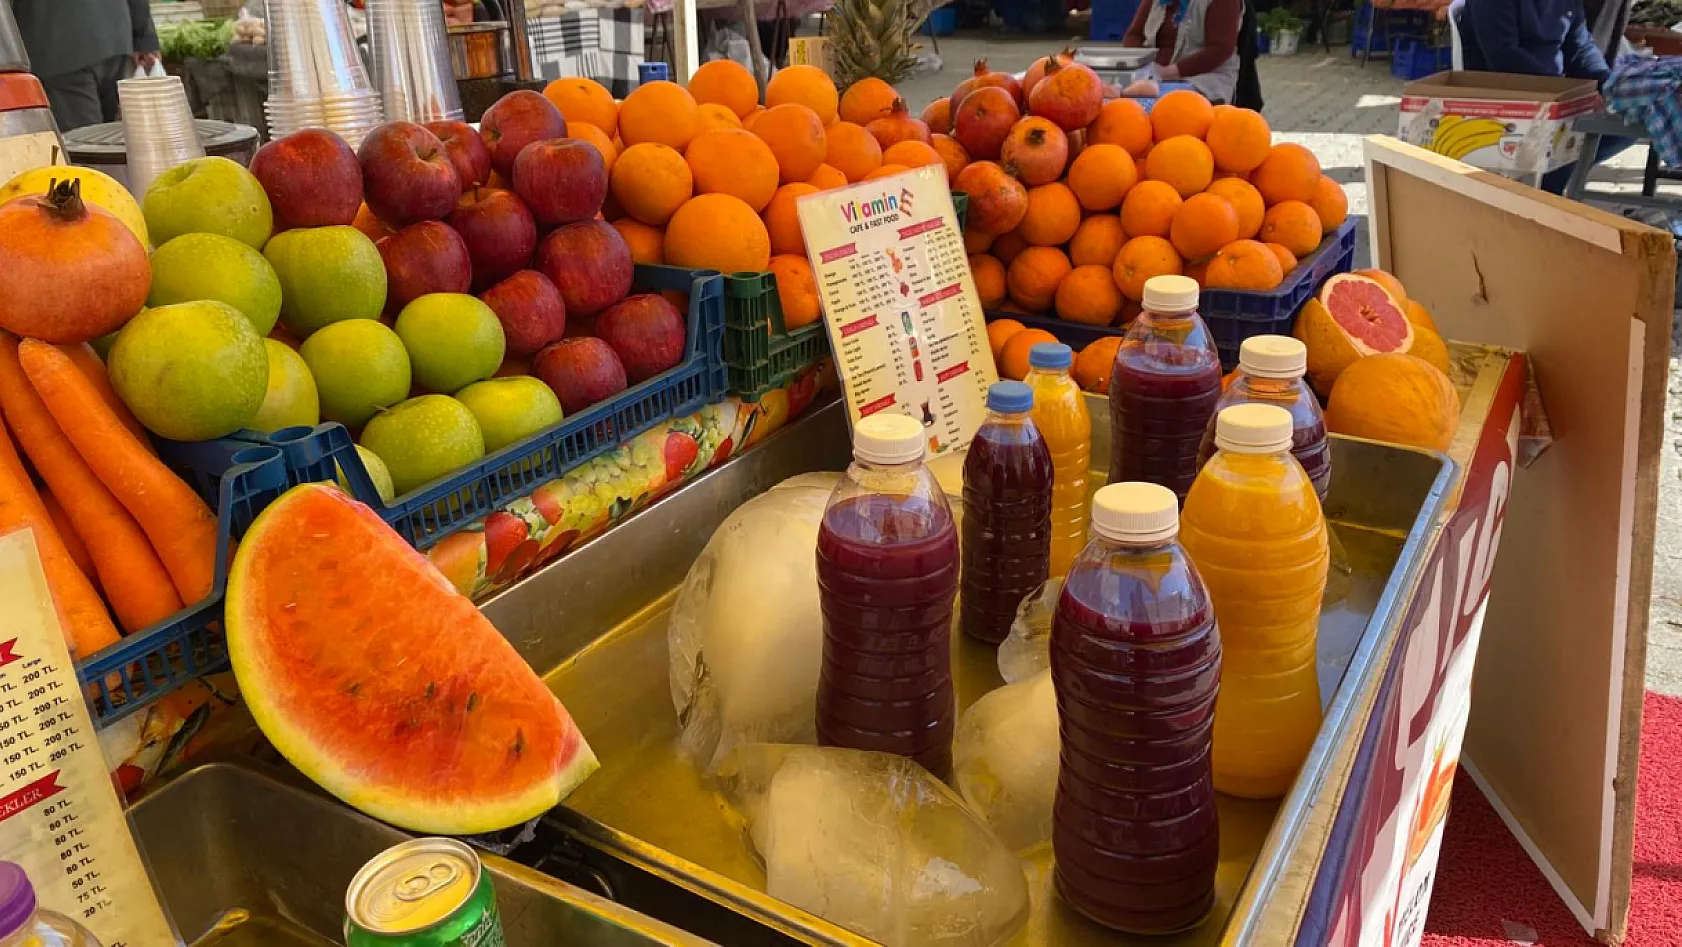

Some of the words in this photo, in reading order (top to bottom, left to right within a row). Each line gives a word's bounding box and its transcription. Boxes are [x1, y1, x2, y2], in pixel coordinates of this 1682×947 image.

[840, 192, 898, 223] Vitamin
[22, 671, 40, 684] 200
[42, 666, 58, 675] TL.
[28, 686, 46, 700] 200
[47, 681, 64, 690] TL.
[12, 715, 29, 725] TL.
[33, 702, 51, 716] 200
[52, 696, 69, 706] TL.
[17, 730, 35, 741] TL.
[38, 717, 56, 731] 200
[58, 711, 74, 721] TL.
[3, 752, 21, 766] 150
[23, 746, 40, 756] TL.
[44, 733, 62, 747] 200
[63, 727, 80, 738] TL.
[9, 768, 27, 781] 150
[28, 761, 46, 772] TL.
[50, 748, 67, 762] 200
[68, 742, 84, 752] TL.
[57, 799, 73, 808] TL.
[62, 814, 79, 824] TL.
[68, 828, 84, 838] TL.
[74, 842, 90, 852] TL.
[80, 857, 96, 867] TL.
[72, 877, 84, 889] 50
[84, 872, 101, 881] TL.
[77, 892, 90, 903] 75
[90, 886, 107, 895] TL.
[84, 906, 96, 918] 20
